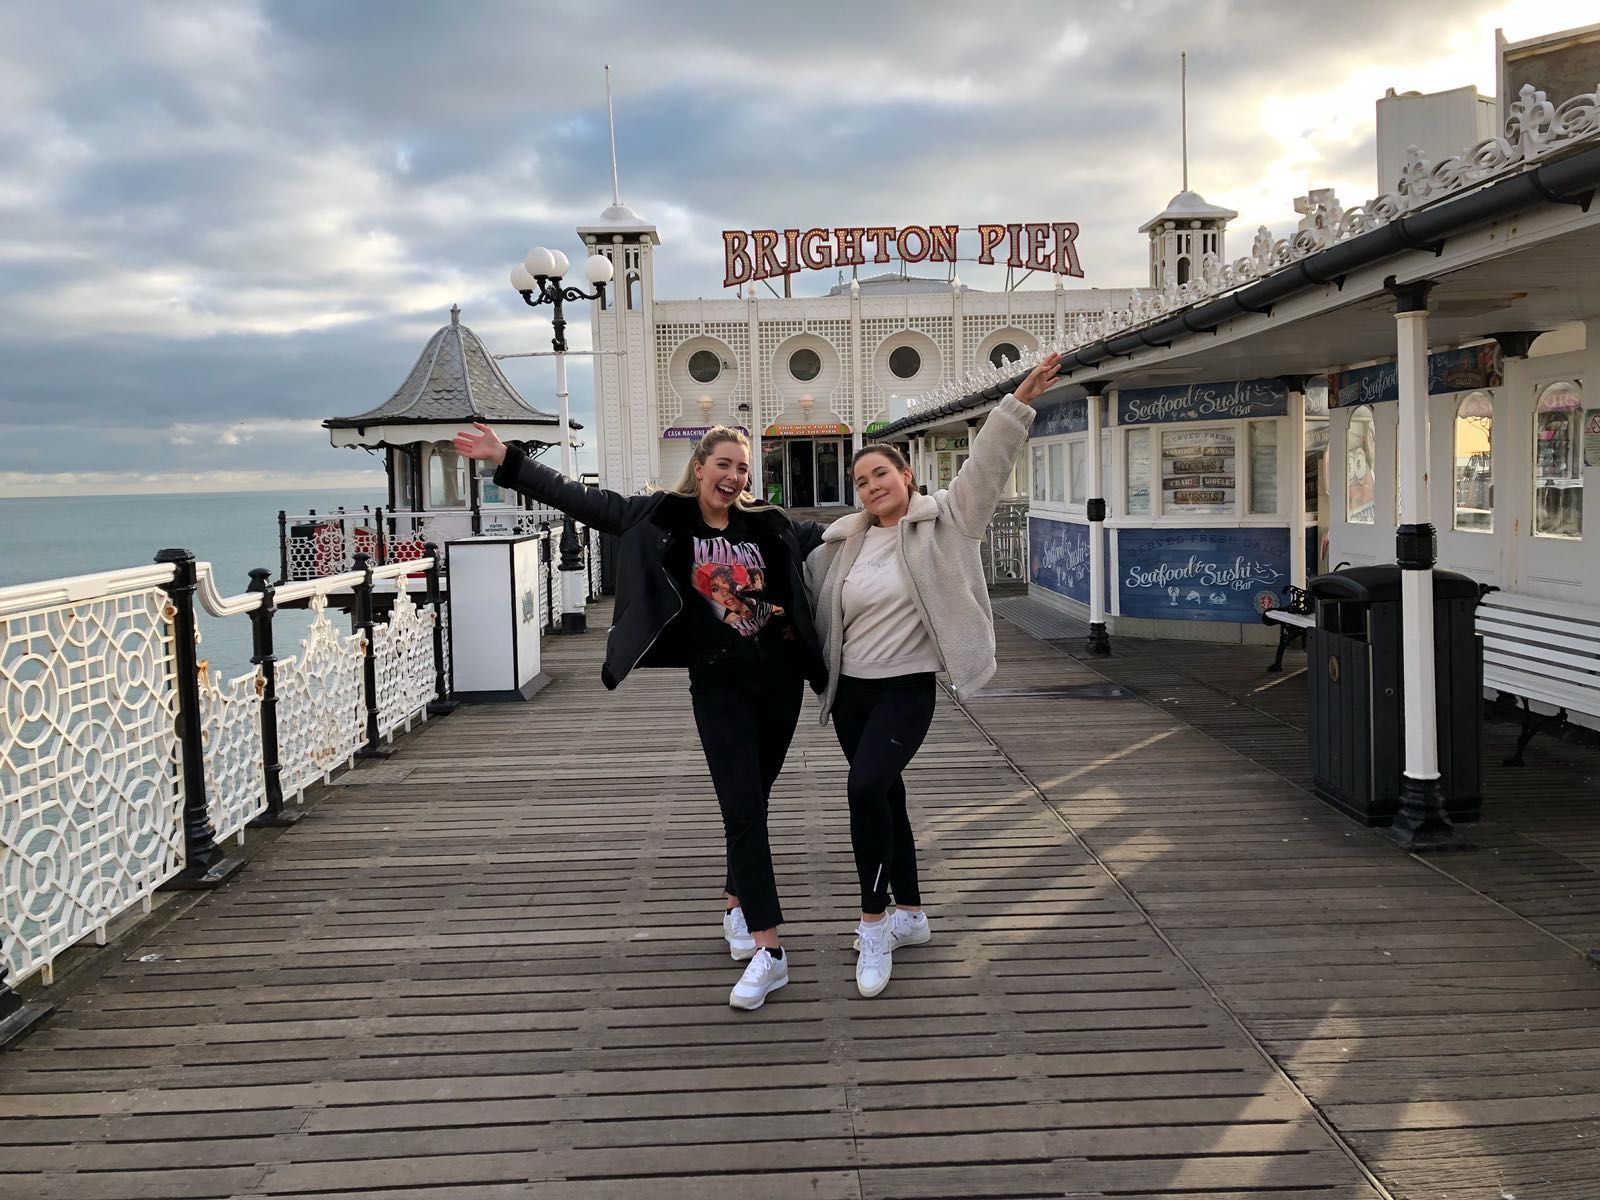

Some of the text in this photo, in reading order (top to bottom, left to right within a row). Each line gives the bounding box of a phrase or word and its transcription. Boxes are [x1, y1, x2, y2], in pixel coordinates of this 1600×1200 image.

[723, 222, 1085, 287] BRIGHTON PIER
[1124, 384, 1196, 422] Seafood
[1200, 380, 1250, 414] Sushi
[1230, 404, 1253, 417] Bar
[682, 429, 705, 437] MACHINE
[1205, 478, 1235, 487] WHELKS
[1129, 536, 1184, 557] SERVED
[1191, 534, 1237, 545] FRESH
[1126, 555, 1252, 588] Seafood & Sushi
[1231, 579, 1254, 592] Bar
